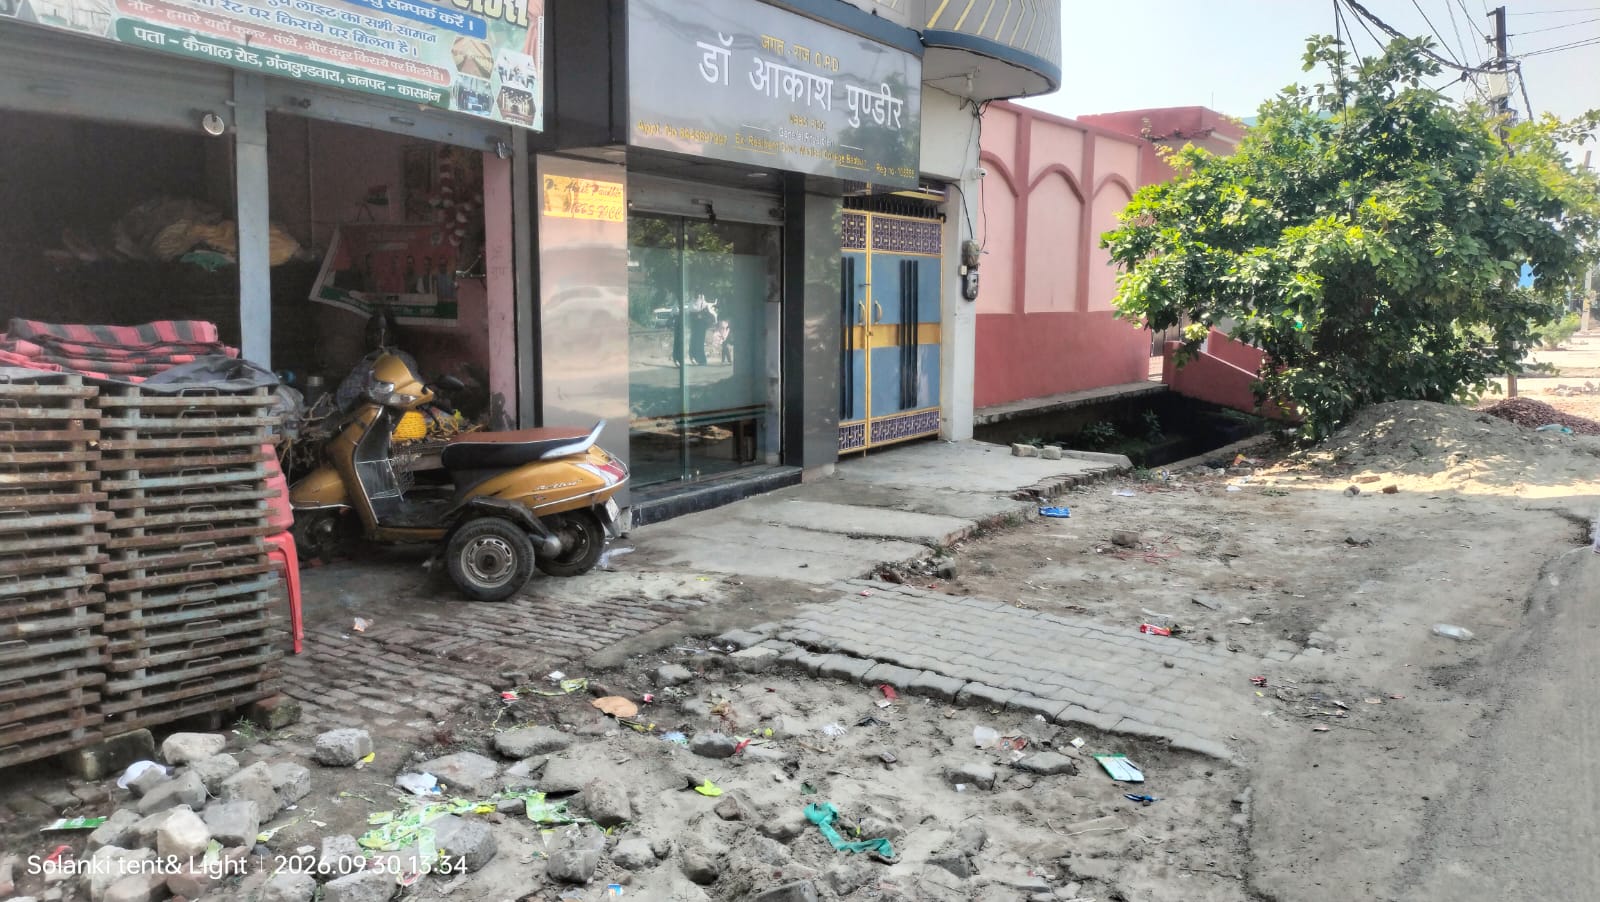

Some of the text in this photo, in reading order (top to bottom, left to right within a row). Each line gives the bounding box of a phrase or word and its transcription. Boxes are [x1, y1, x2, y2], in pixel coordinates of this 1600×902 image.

[248, 6, 271, 21] पर
[275, 10, 324, 33] किराये
[329, 26, 349, 39] पर
[352, 28, 395, 50] मिलता
[296, 1, 337, 17] लाइट
[341, 10, 361, 24] का
[364, 15, 393, 32] सभी
[396, 25, 437, 43] सामान
[386, 0, 436, 19] सम्पर्क
[438, 11, 464, 28] करें
[165, 9, 202, 24] हमारे
[304, 40, 328, 54] और
[354, 49, 390, 67] किराये
[390, 60, 405, 71] पर
[761, 34, 784, 56] जगत
[792, 43, 811, 64] राज
[133, 27, 165, 45] पता
[182, 35, 232, 60] कैनाल
[234, 47, 263, 67] रोड,
[347, 73, 386, 92] जनपद
[397, 83, 442, 103] कासगंज
[696, 32, 904, 129] डॉ आकाश पुण्डीर
